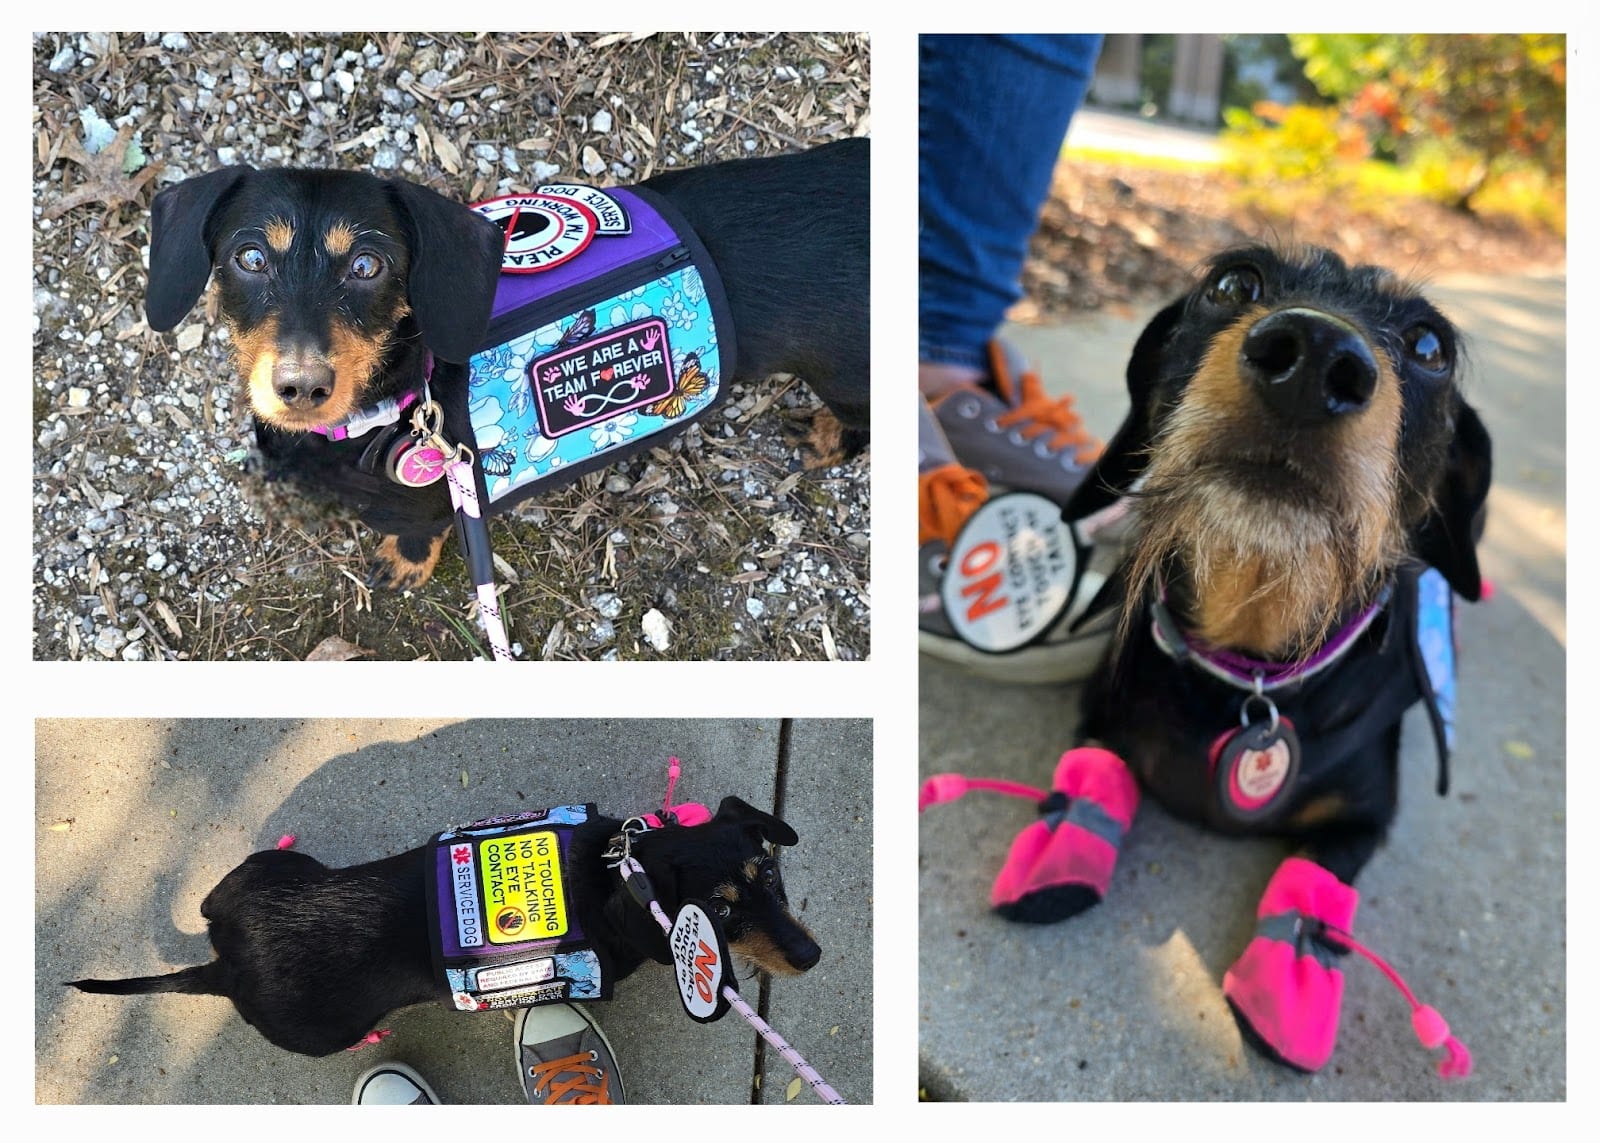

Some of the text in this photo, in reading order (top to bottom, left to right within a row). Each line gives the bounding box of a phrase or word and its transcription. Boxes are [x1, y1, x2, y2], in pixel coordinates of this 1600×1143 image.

[505, 198, 581, 221] WORKING
[542, 187, 621, 227] SERVICE DOG
[502, 245, 564, 266] PLEAS
[543, 350, 663, 403] TEAM FREVER
[560, 337, 639, 377] WE ARE A
[959, 539, 1010, 622] NO
[488, 844, 506, 906] CONTACT
[503, 842, 521, 894] NO EYE
[520, 840, 541, 923] NO TALKING
[536, 837, 559, 932] NO TOUCHING
[457, 866, 478, 945] SERVICE DOG
[674, 926, 684, 963] TALK
[680, 915, 691, 967] TOUCH
[686, 942, 697, 1003] CONTACT
[694, 938, 718, 1004] NO
